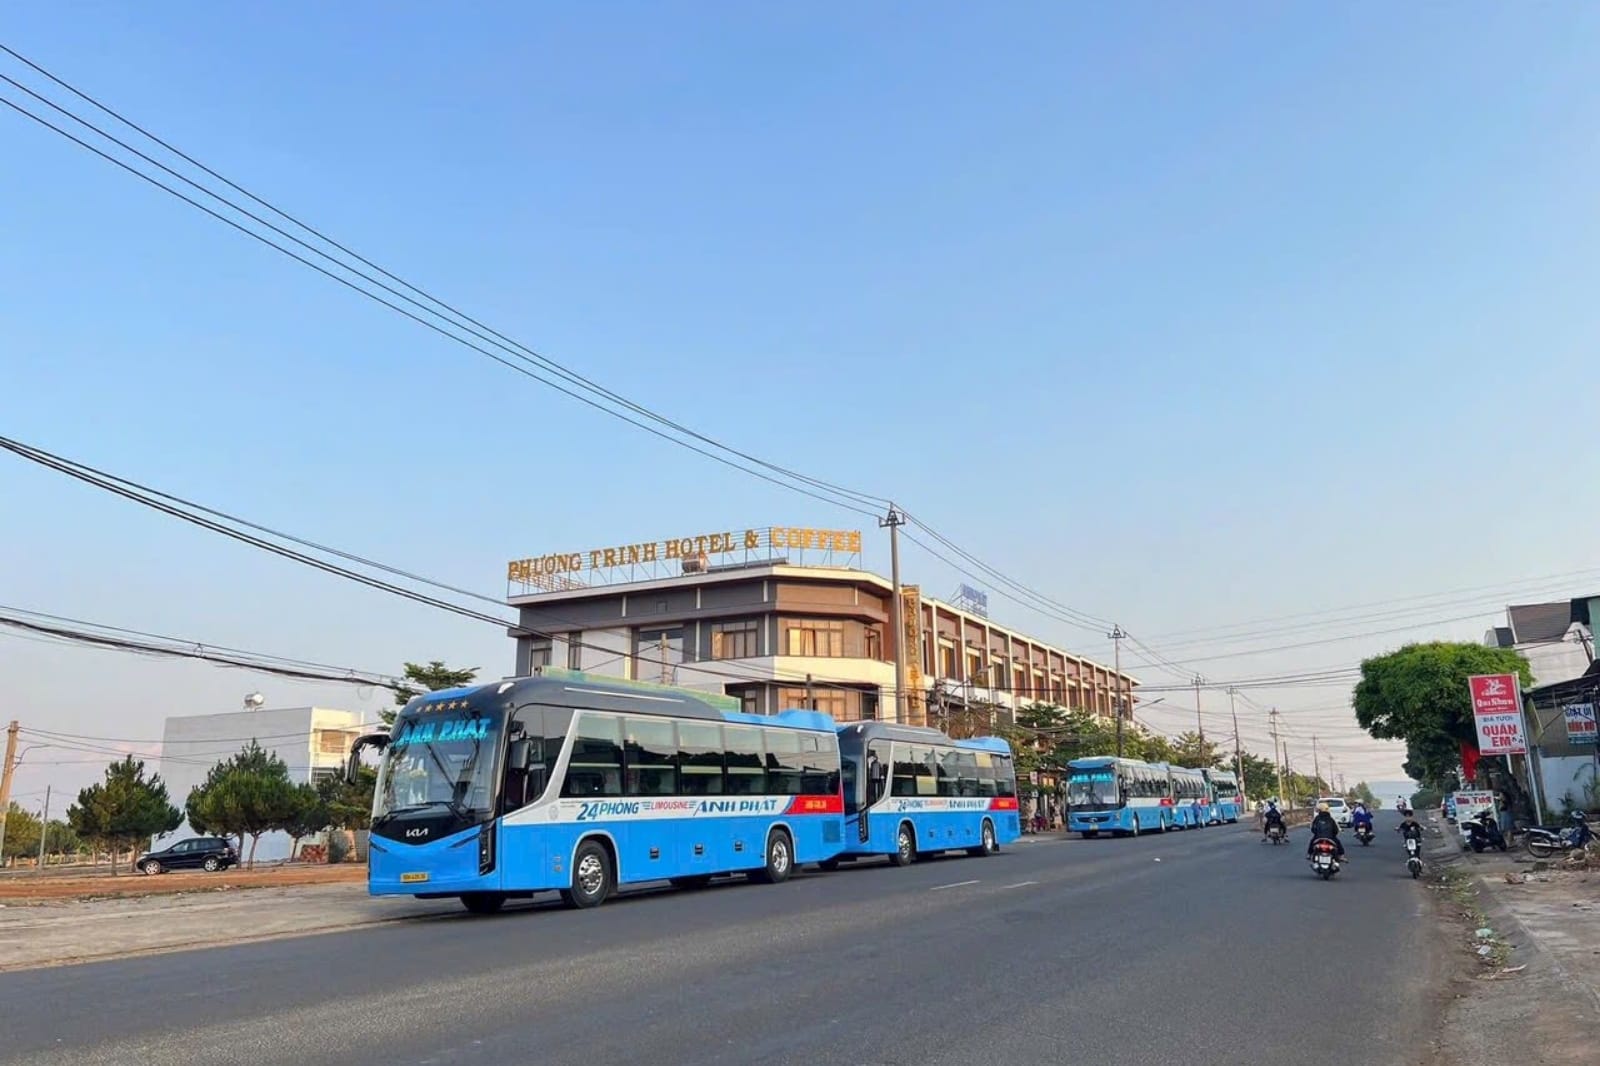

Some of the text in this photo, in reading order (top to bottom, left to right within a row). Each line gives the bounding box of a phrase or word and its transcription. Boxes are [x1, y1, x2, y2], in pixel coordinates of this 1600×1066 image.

[589, 542, 657, 569] TRINH
[665, 532, 737, 559] HOTEL
[744, 529, 759, 549] &
[771, 527, 861, 553] COFFEE
[1491, 736, 1511, 747] EM
[576, 802, 599, 821] 24
[651, 800, 688, 811] LIMOUSINE
[693, 799, 736, 816] ANH
